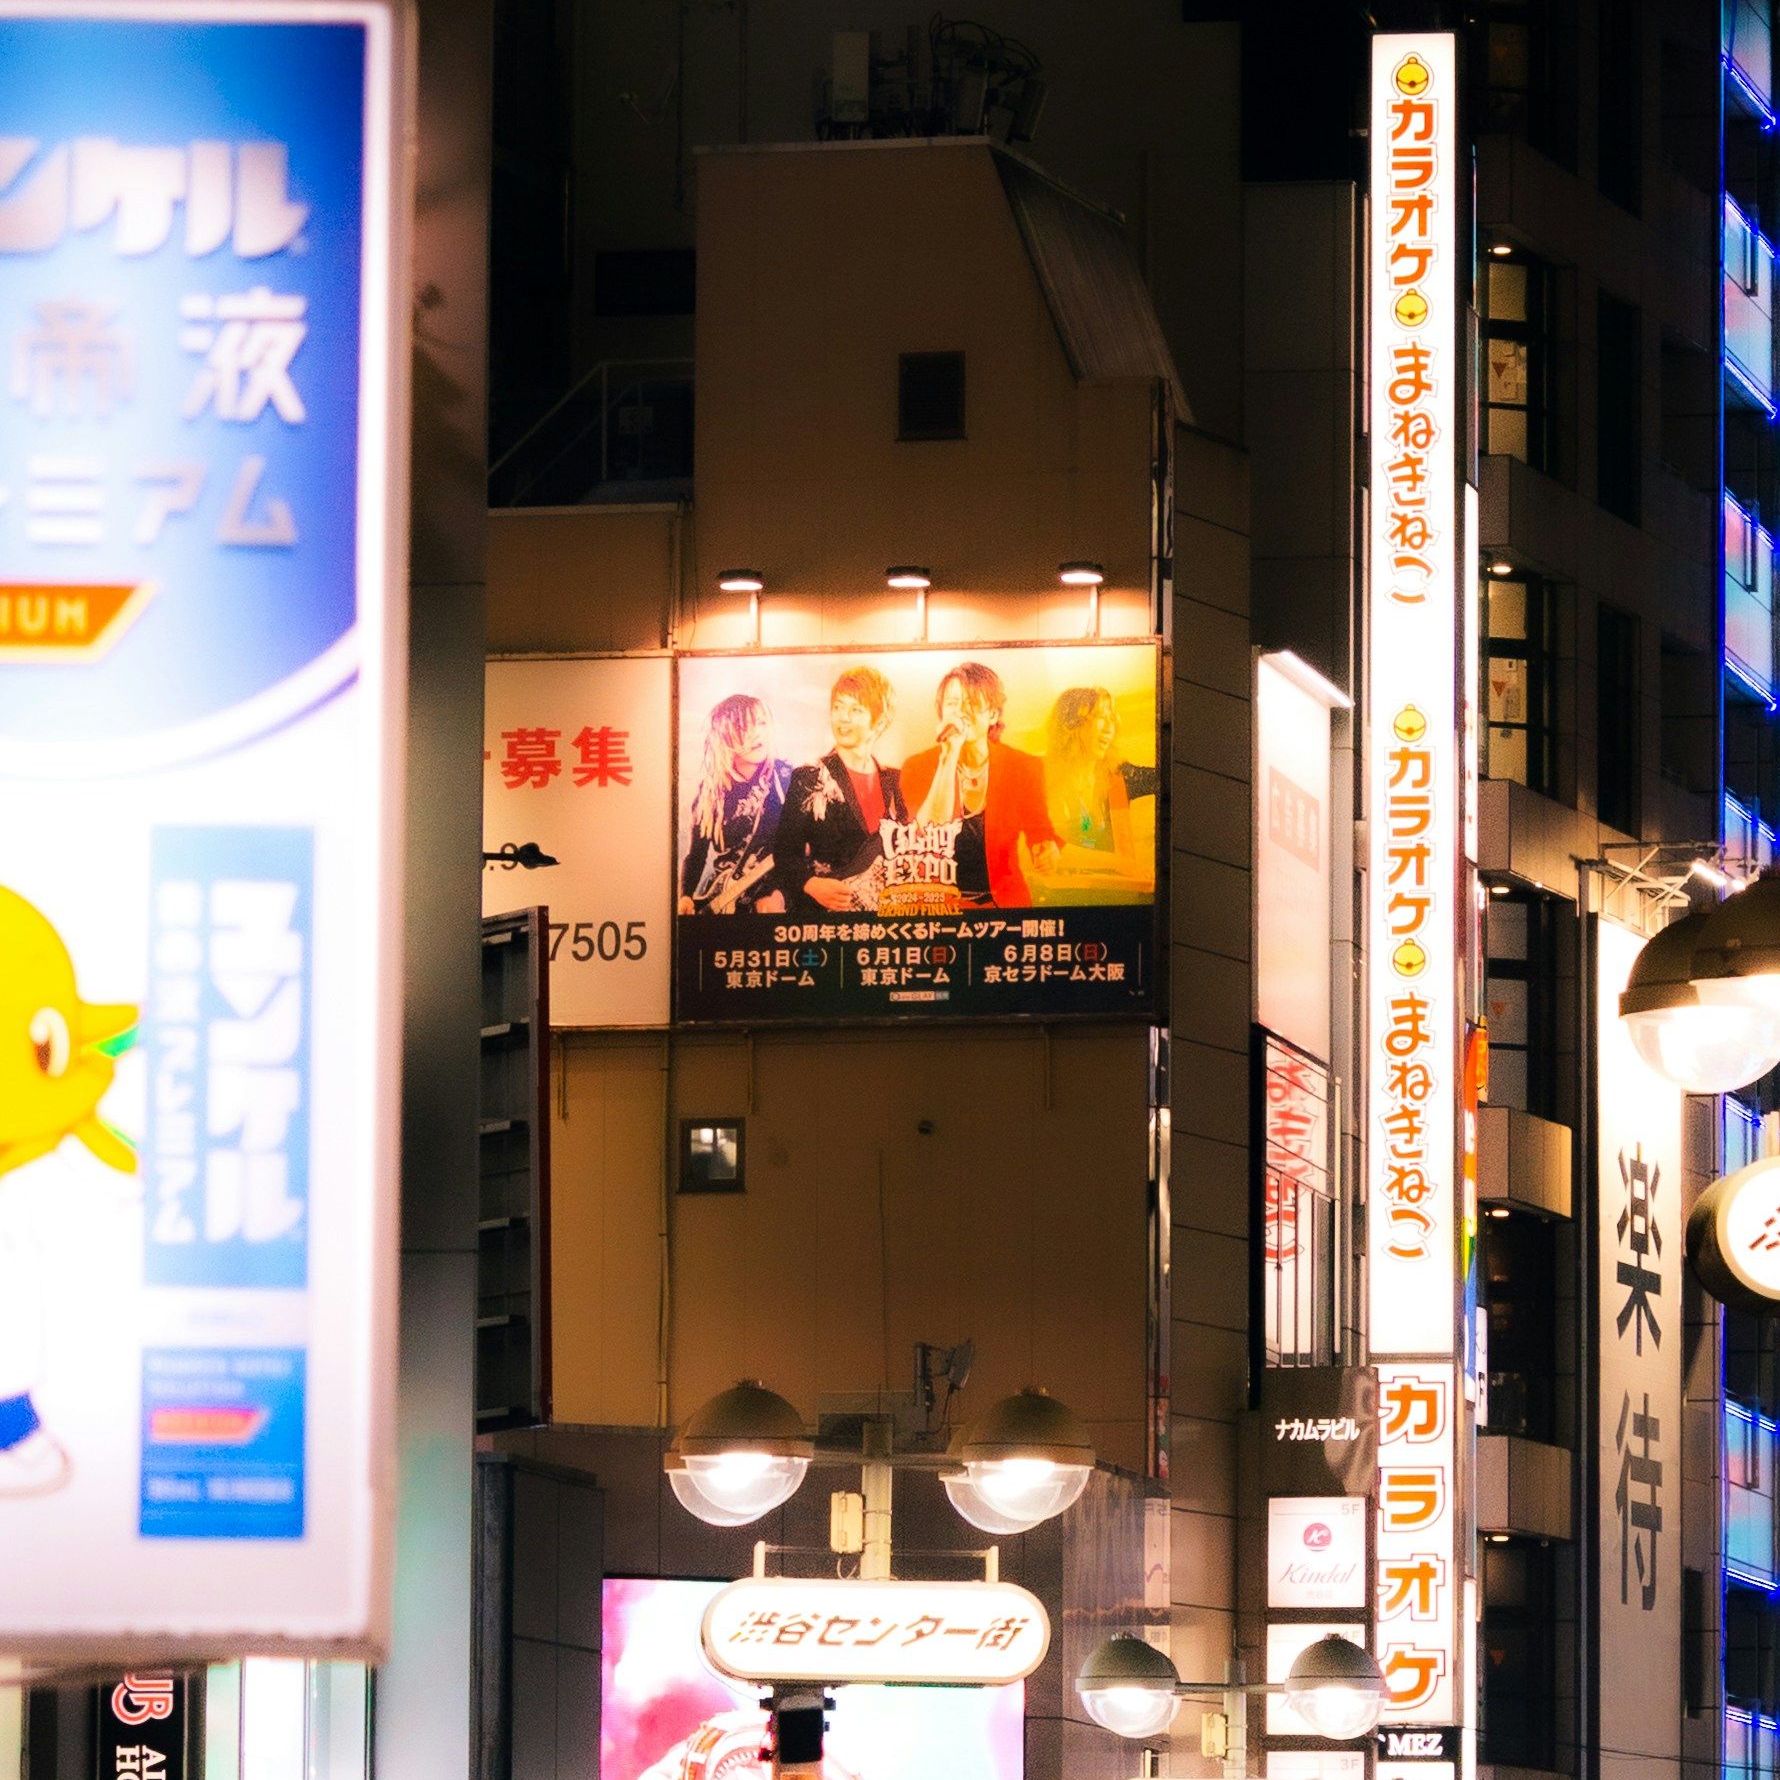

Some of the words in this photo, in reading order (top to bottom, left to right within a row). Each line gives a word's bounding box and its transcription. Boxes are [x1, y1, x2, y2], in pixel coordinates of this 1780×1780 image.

[1390, 99, 1434, 287] カラオケ
[1387, 340, 1437, 606] まねきねこ
[484, 726, 634, 790] 募集
[1387, 745, 1432, 937] カラオケ
[885, 855, 958, 886] EXPO
[878, 904, 919, 918] GRAND
[921, 903, 963, 917] FINALE
[725, 971, 816, 989] 東京ドーム
[860, 968, 951, 986] 東京ドーム
[983, 963, 1126, 983] 京セラドーム大阪
[1384, 990, 1436, 1259] まねきねこ
[1614, 1141, 1665, 1612] 楽待
[1274, 1418, 1360, 1441] ナカムラビル
[1341, 1503, 1360, 1516] 5F
[1386, 1382, 1438, 1707] カラオケ
[1279, 1562, 1358, 1585] Kindal
[728, 1611, 1029, 1651] 渋谷センター街
